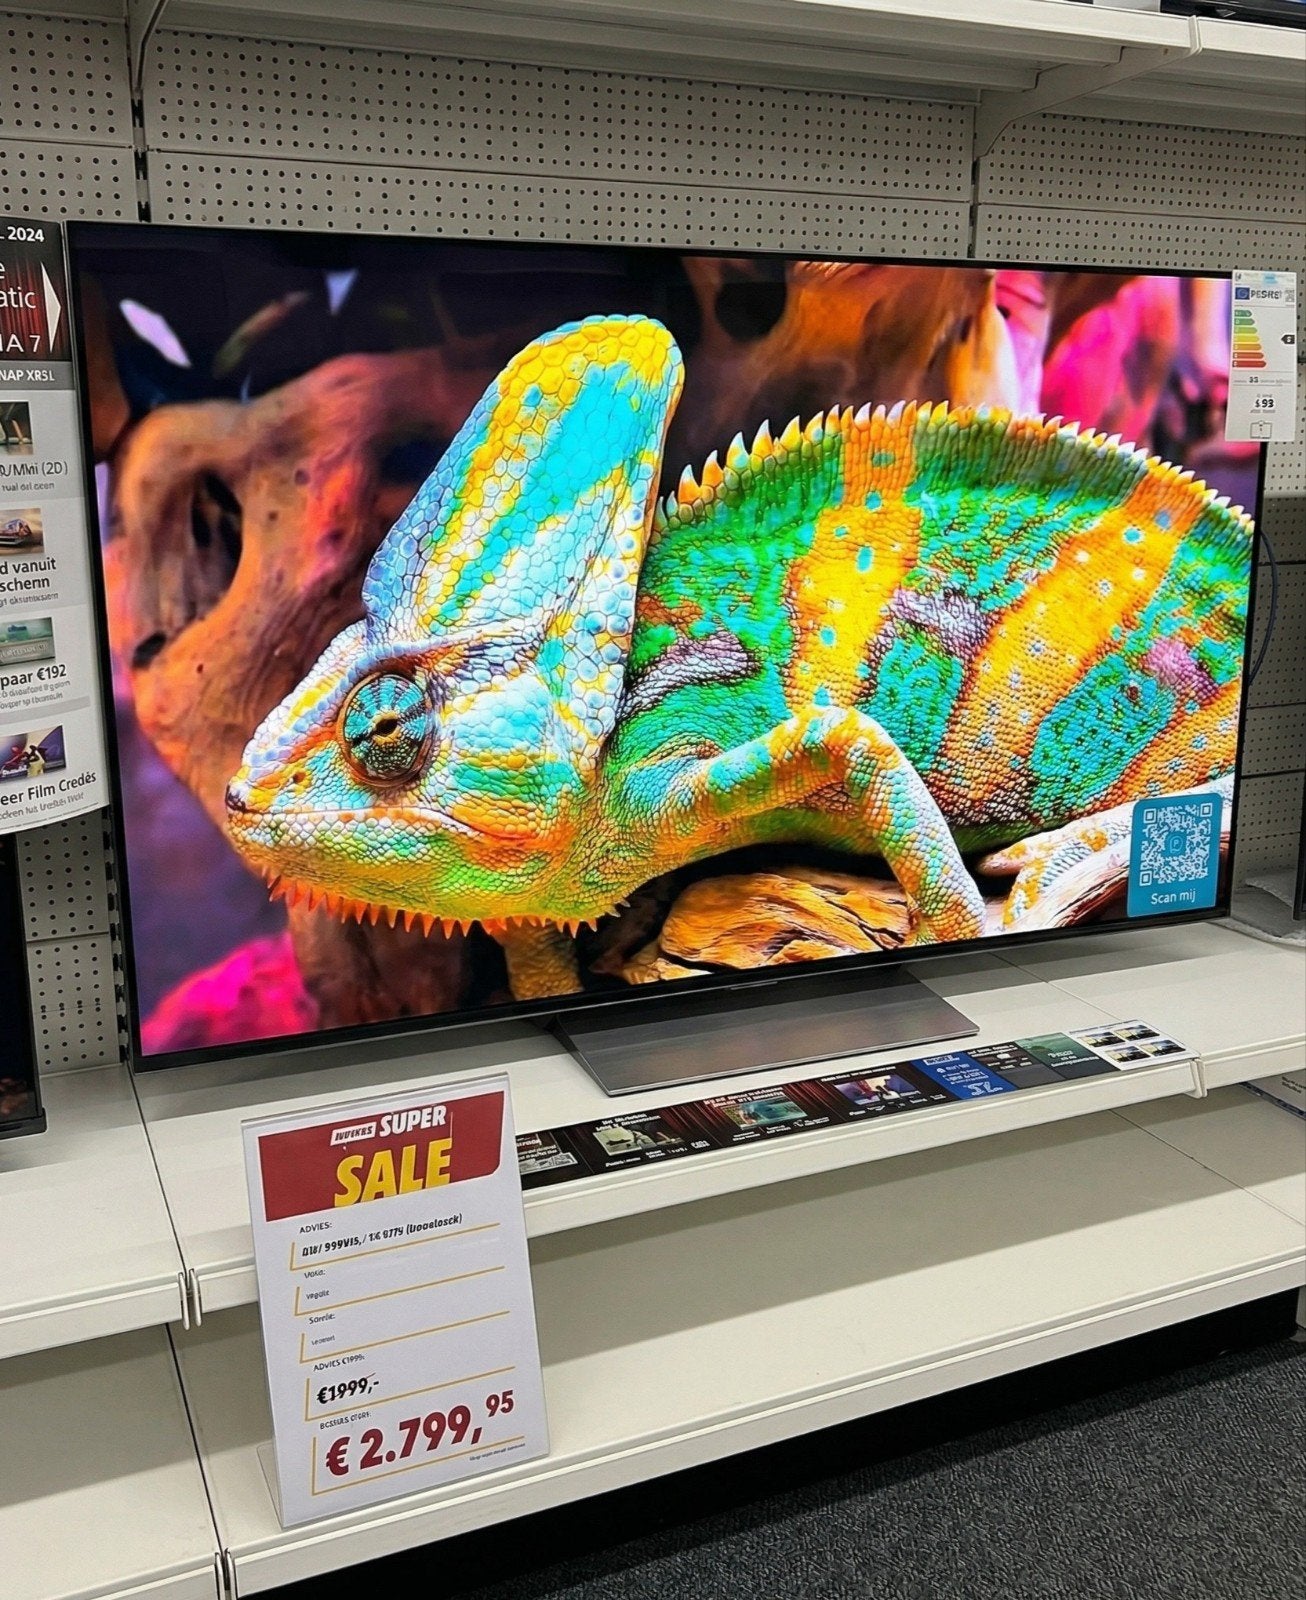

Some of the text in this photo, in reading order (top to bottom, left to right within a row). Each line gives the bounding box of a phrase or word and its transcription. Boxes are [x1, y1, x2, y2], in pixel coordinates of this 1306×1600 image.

[7, 226, 45, 242] 2024
[29, 334, 41, 353] 7
[12, 557, 57, 574] vanuit
[0, 672, 34, 690] paar
[37, 664, 67, 681] €192
[0, 792, 25, 806] eer
[28, 785, 56, 801] Film
[1150, 888, 1196, 905] Scan mij
[379, 1105, 447, 1138] SUPER
[334, 1137, 453, 1208] SALE
[299, 1221, 333, 1234] ADVIES:
[316, 1377, 379, 1404] €1999,-
[325, 1436, 351, 1476] €
[359, 1404, 482, 1469] 2.799,
[485, 1390, 515, 1417] 95
